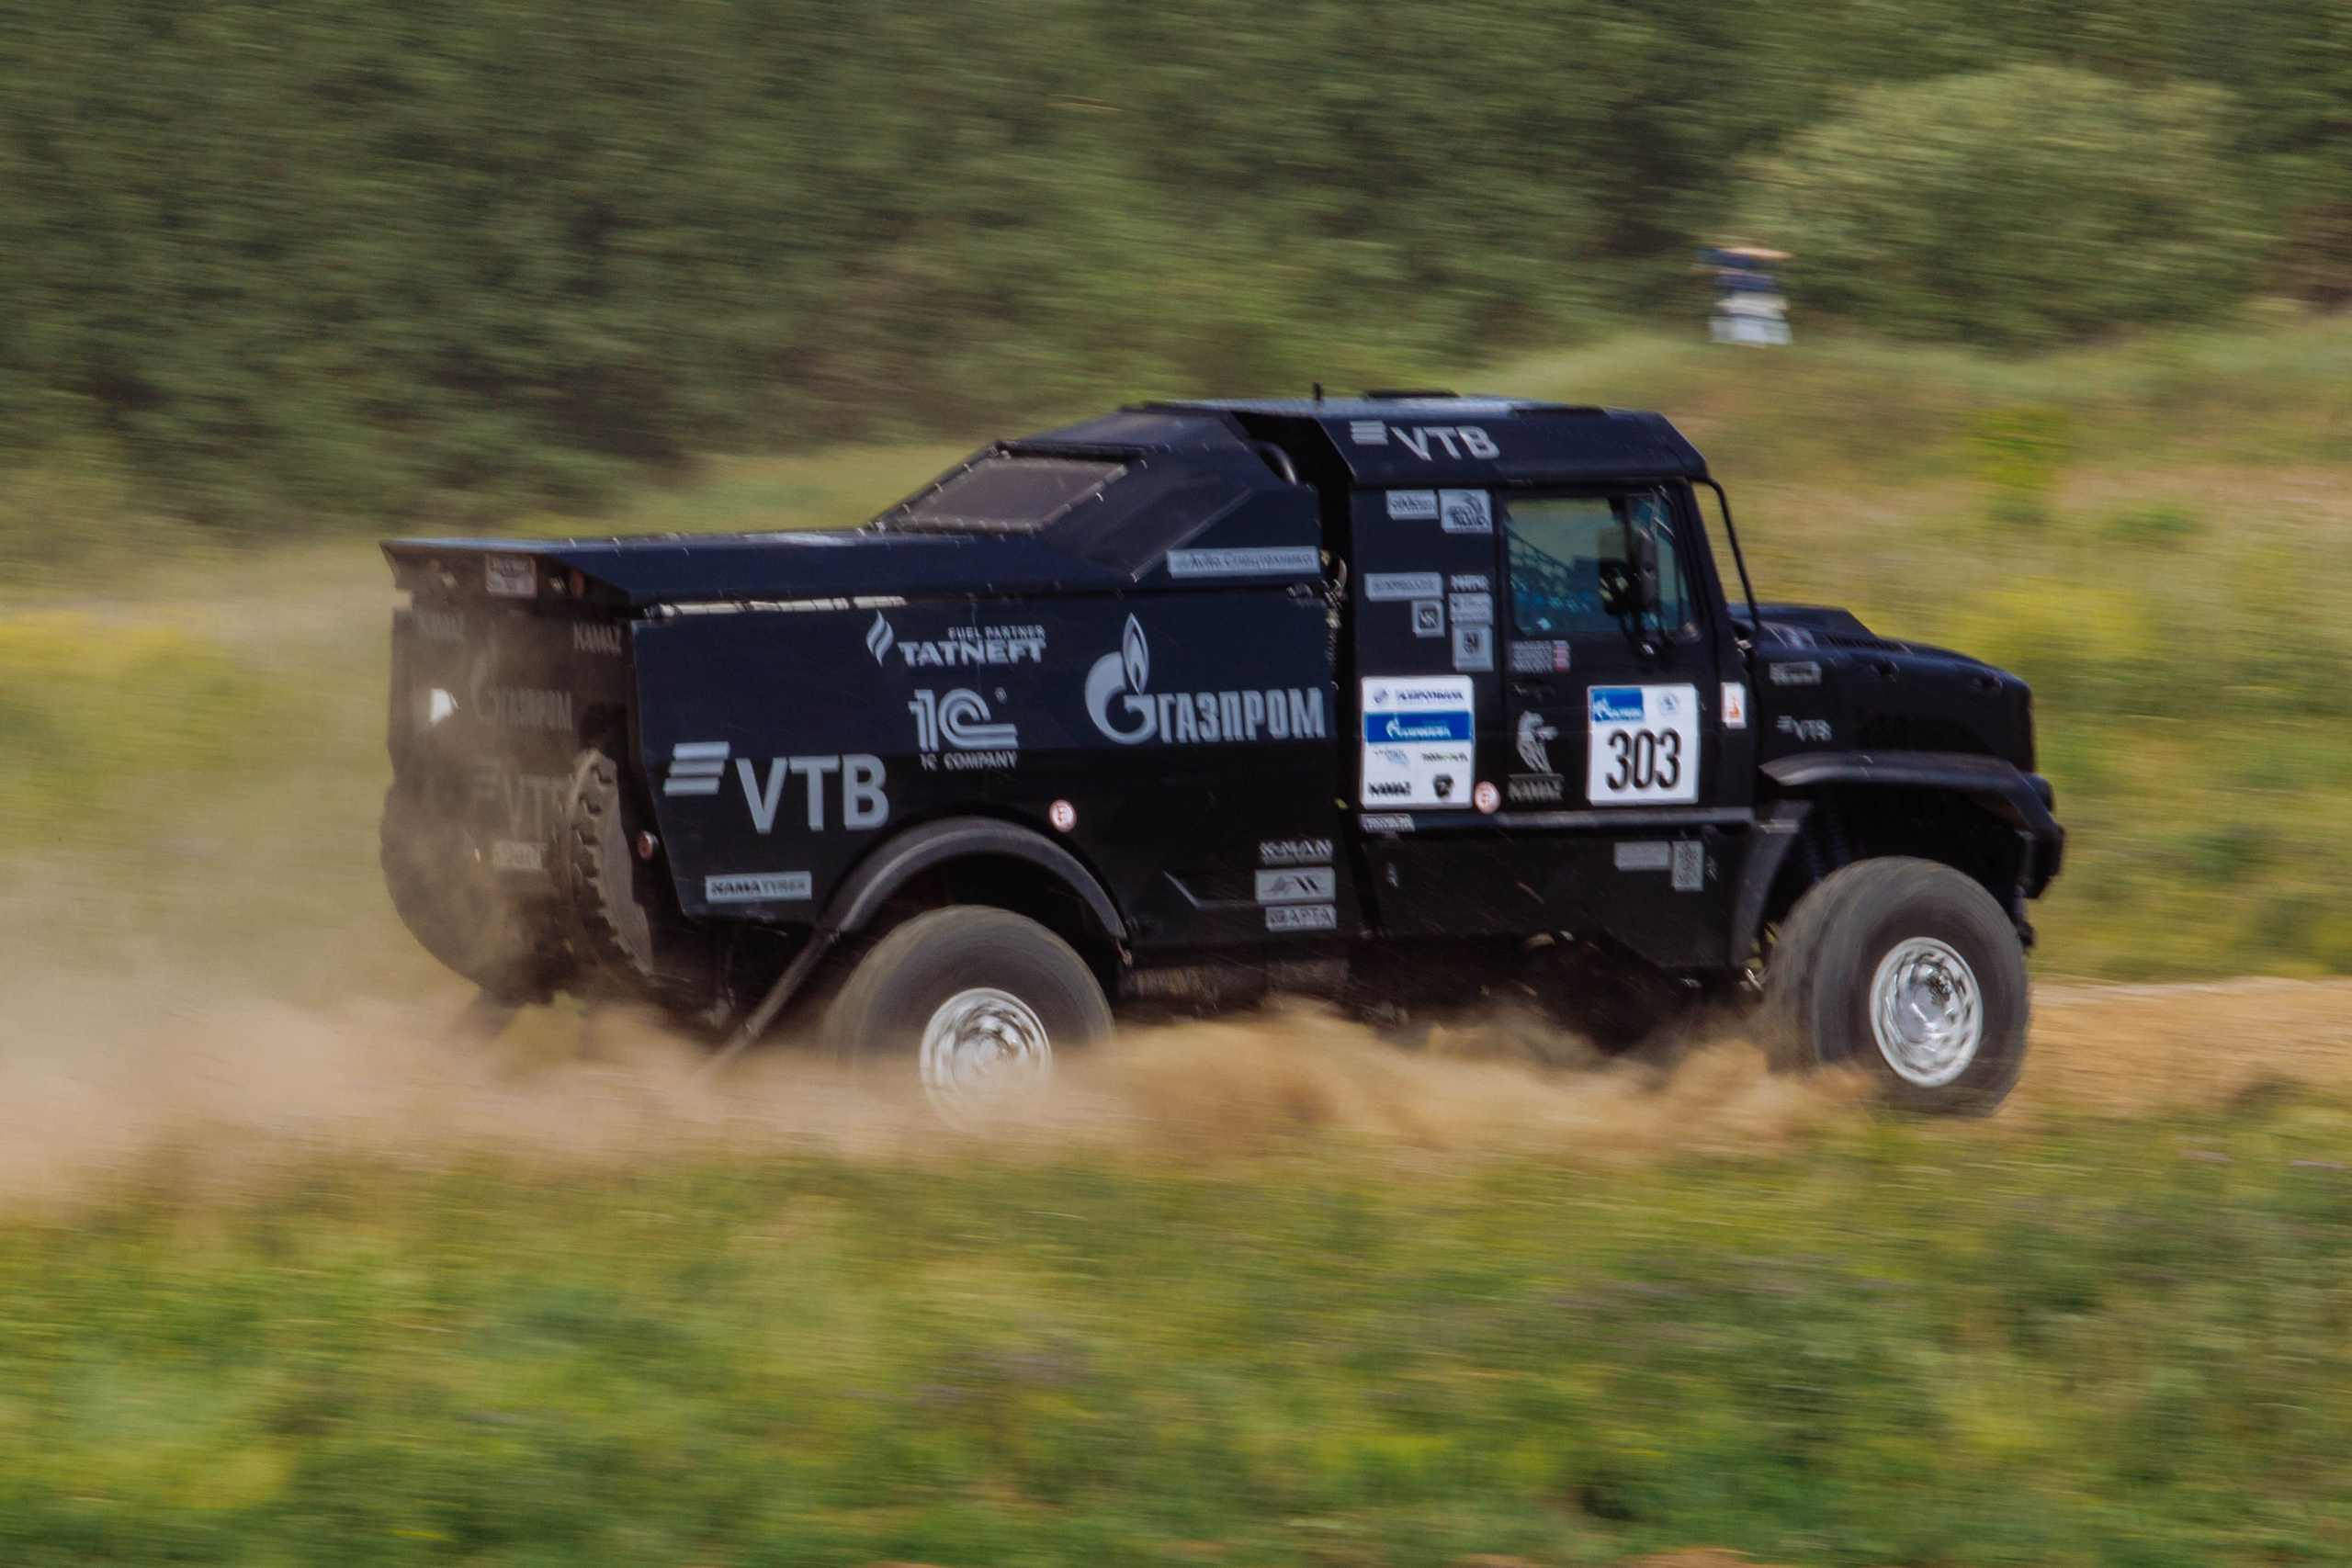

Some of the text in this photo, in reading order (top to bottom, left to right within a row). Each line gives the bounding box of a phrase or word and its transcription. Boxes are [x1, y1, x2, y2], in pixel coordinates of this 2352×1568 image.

[1390, 425, 1500, 461] VTB
[948, 625, 1046, 642] FUEL PARTNER
[898, 637, 1046, 667] TATNEFT
[1157, 687, 1326, 744] ГАЗПРОМ
[943, 750, 1018, 770] COMPANY
[1605, 728, 1682, 793] 303
[736, 753, 889, 835] VTB
